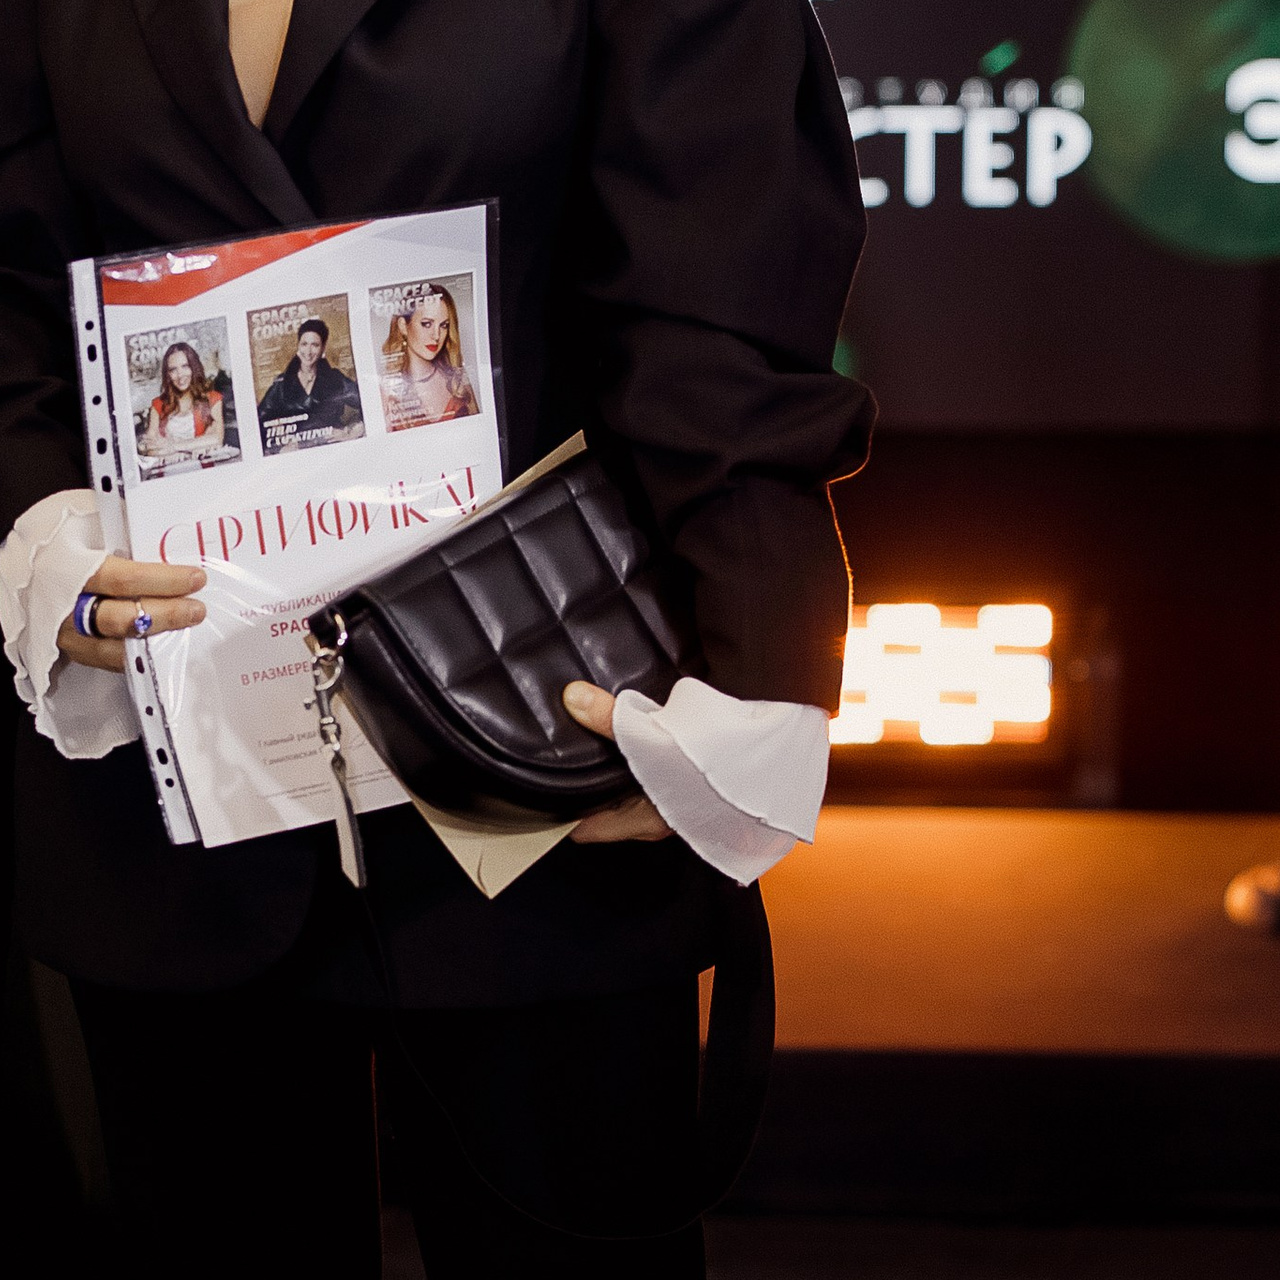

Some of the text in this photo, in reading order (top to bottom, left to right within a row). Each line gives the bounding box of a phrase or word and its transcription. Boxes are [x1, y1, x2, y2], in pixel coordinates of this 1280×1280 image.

[158, 464, 482, 566] СЕРТИФИКАТ
[270, 617, 310, 638] SPAC
[241, 674, 250, 686] В
